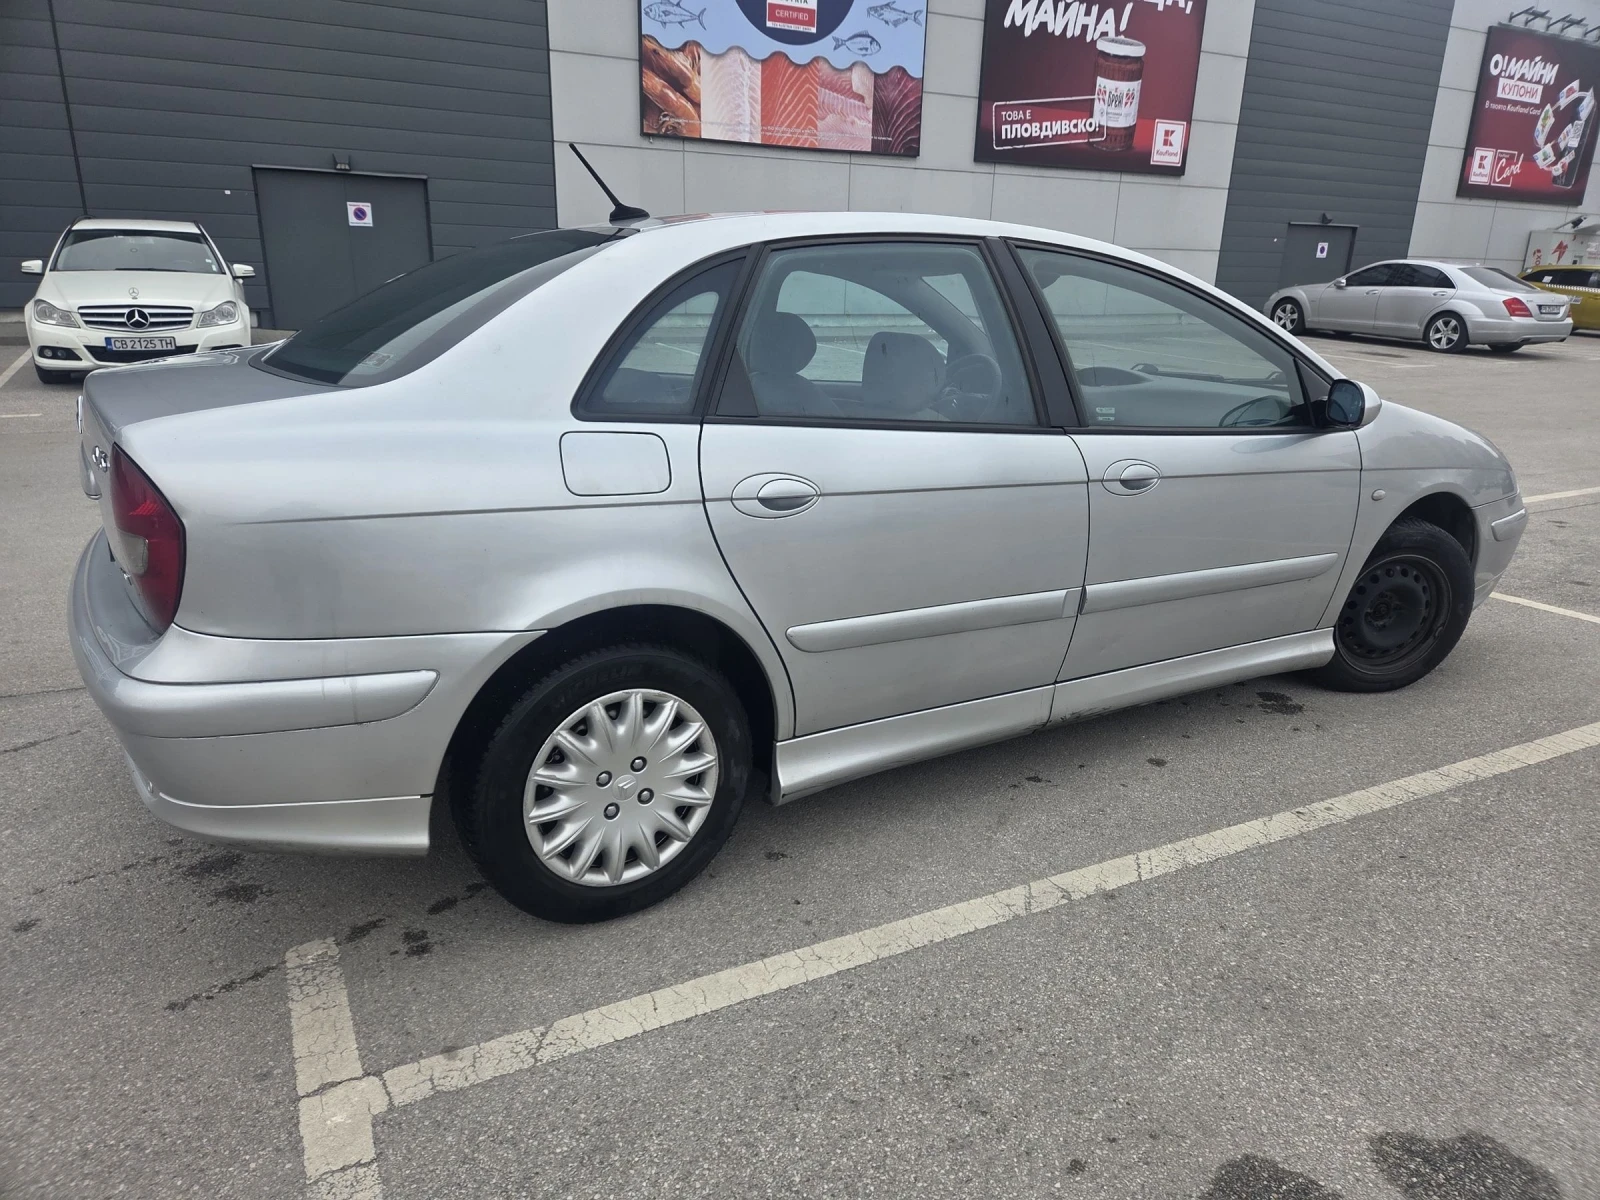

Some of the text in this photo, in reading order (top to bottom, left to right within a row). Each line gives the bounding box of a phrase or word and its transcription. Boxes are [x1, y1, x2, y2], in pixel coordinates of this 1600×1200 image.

[775, 9, 809, 21] CERTIFIED
[1501, 82, 1539, 100] КУПОНИ
[1507, 104, 1530, 114] Kaufland
[1001, 109, 1032, 122] ТОВА Е
[1001, 117, 1100, 140] ПЛОВДИВСКО!
[1156, 149, 1179, 158] Kaufland
[1495, 153, 1525, 182] Card
[130, 339, 157, 349] 2125
